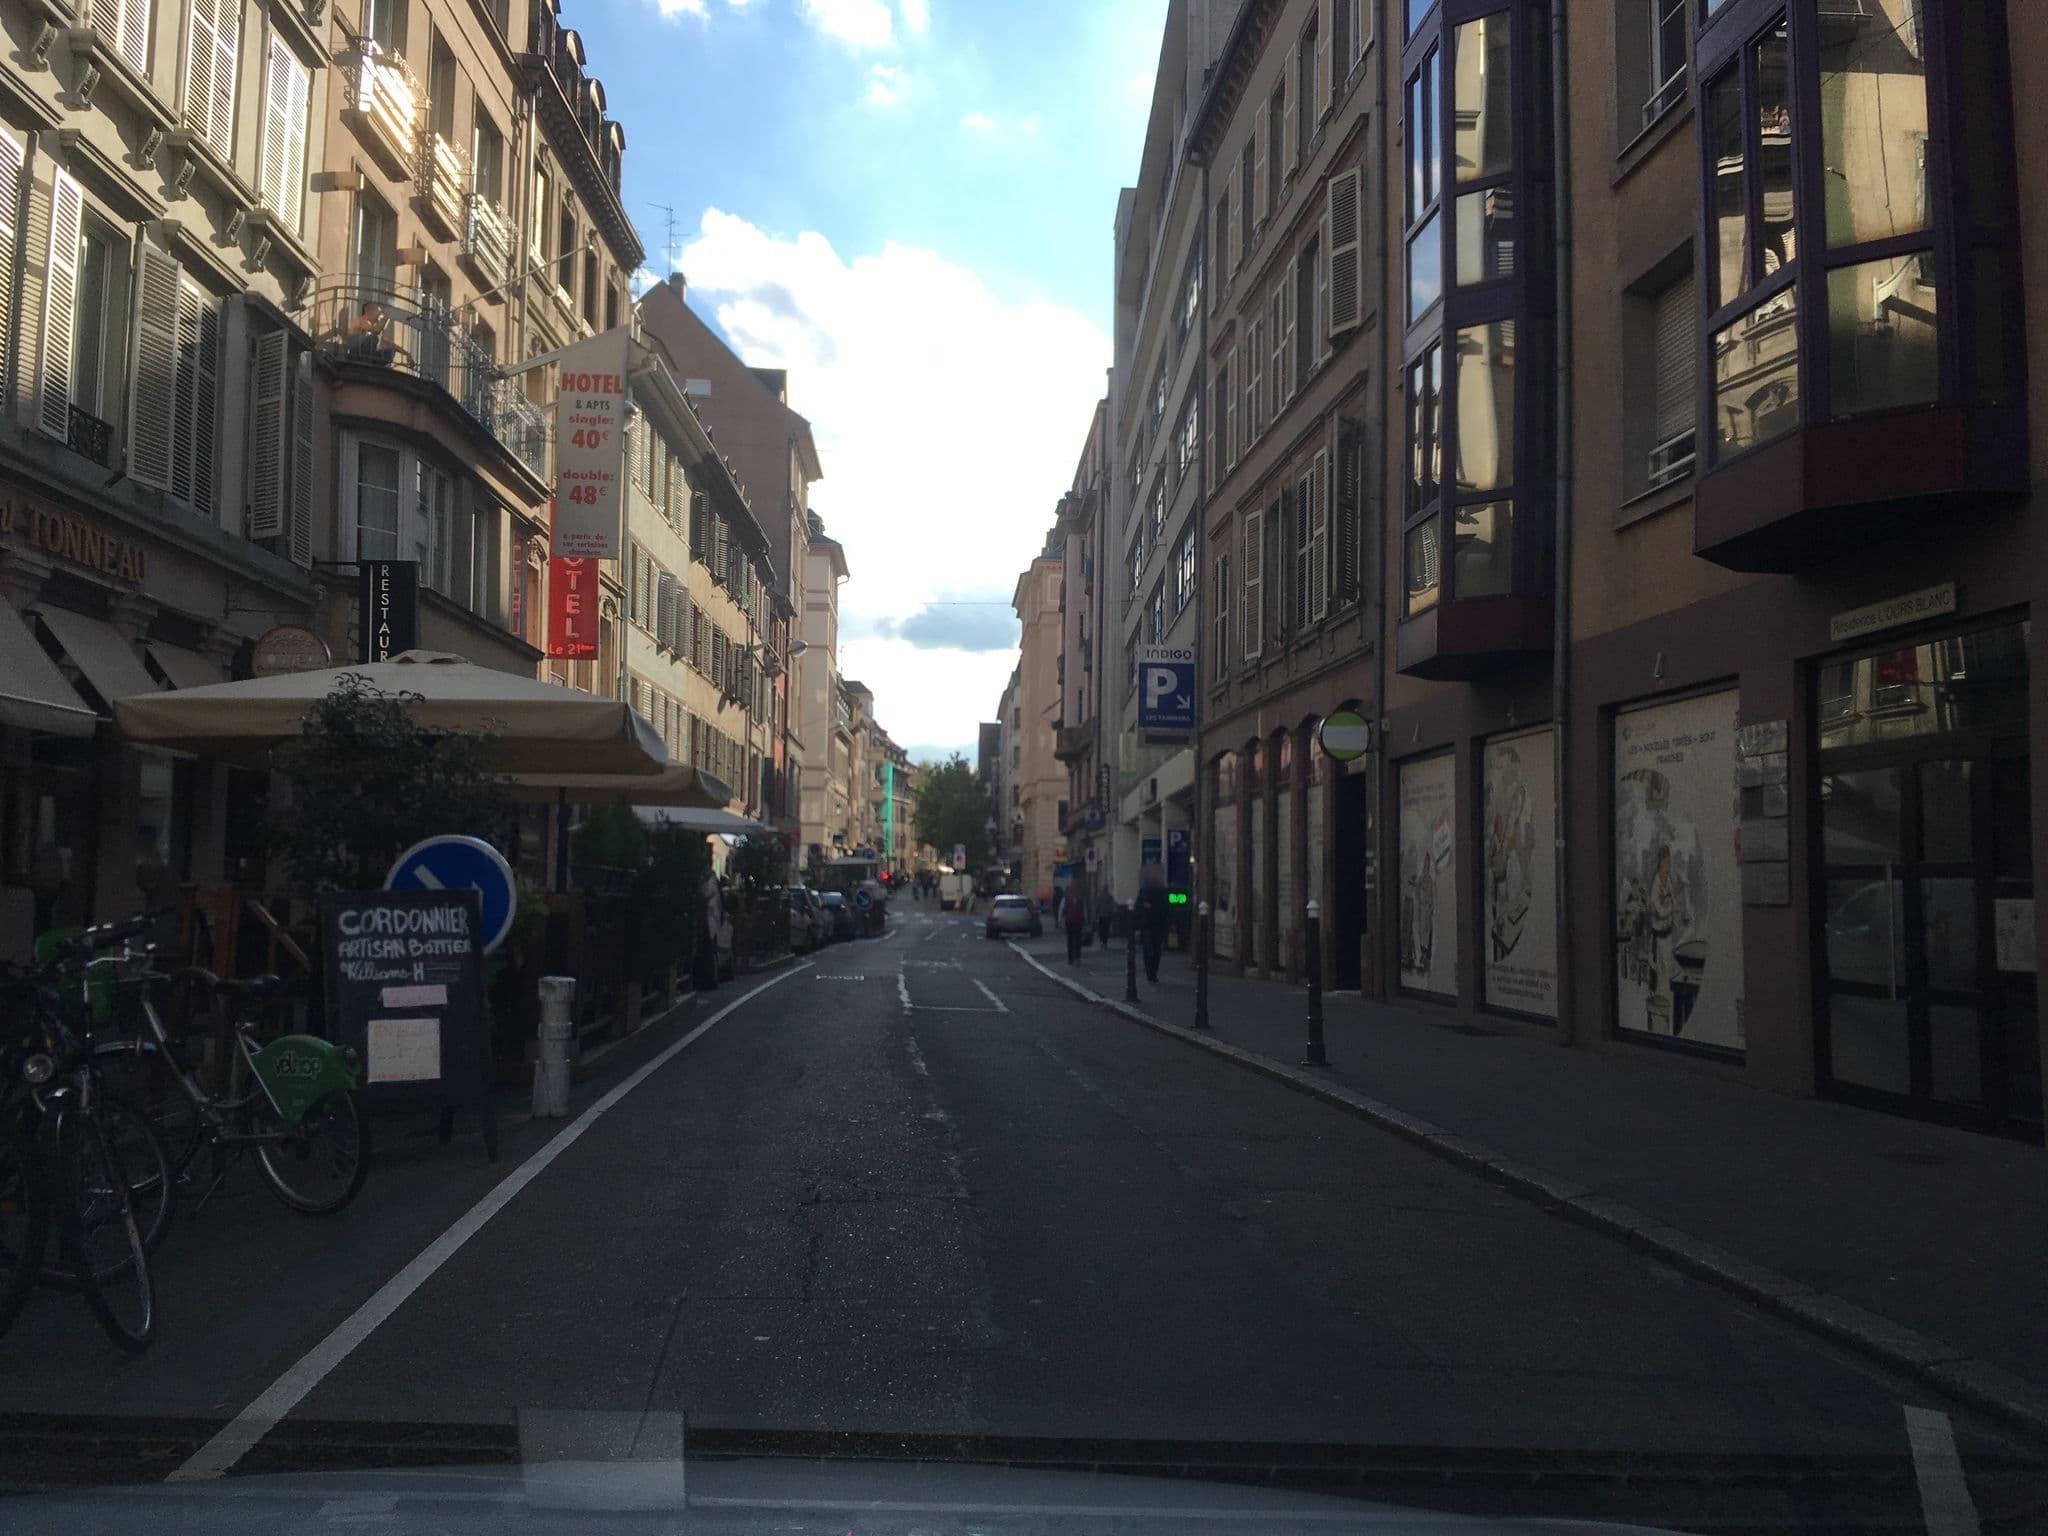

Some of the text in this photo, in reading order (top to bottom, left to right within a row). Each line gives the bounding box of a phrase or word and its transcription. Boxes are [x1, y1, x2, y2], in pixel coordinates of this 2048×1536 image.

[561, 373, 623, 394] HOTEL
[575, 399, 610, 410] & APTS
[562, 470, 614, 481] double:
[26, 502, 145, 583] TONNEAU
[1146, 649, 1192, 660] INDIGO
[1146, 667, 1178, 709] P
[1170, 831, 1182, 848] P
[338, 905, 470, 936] CORDONNIER
